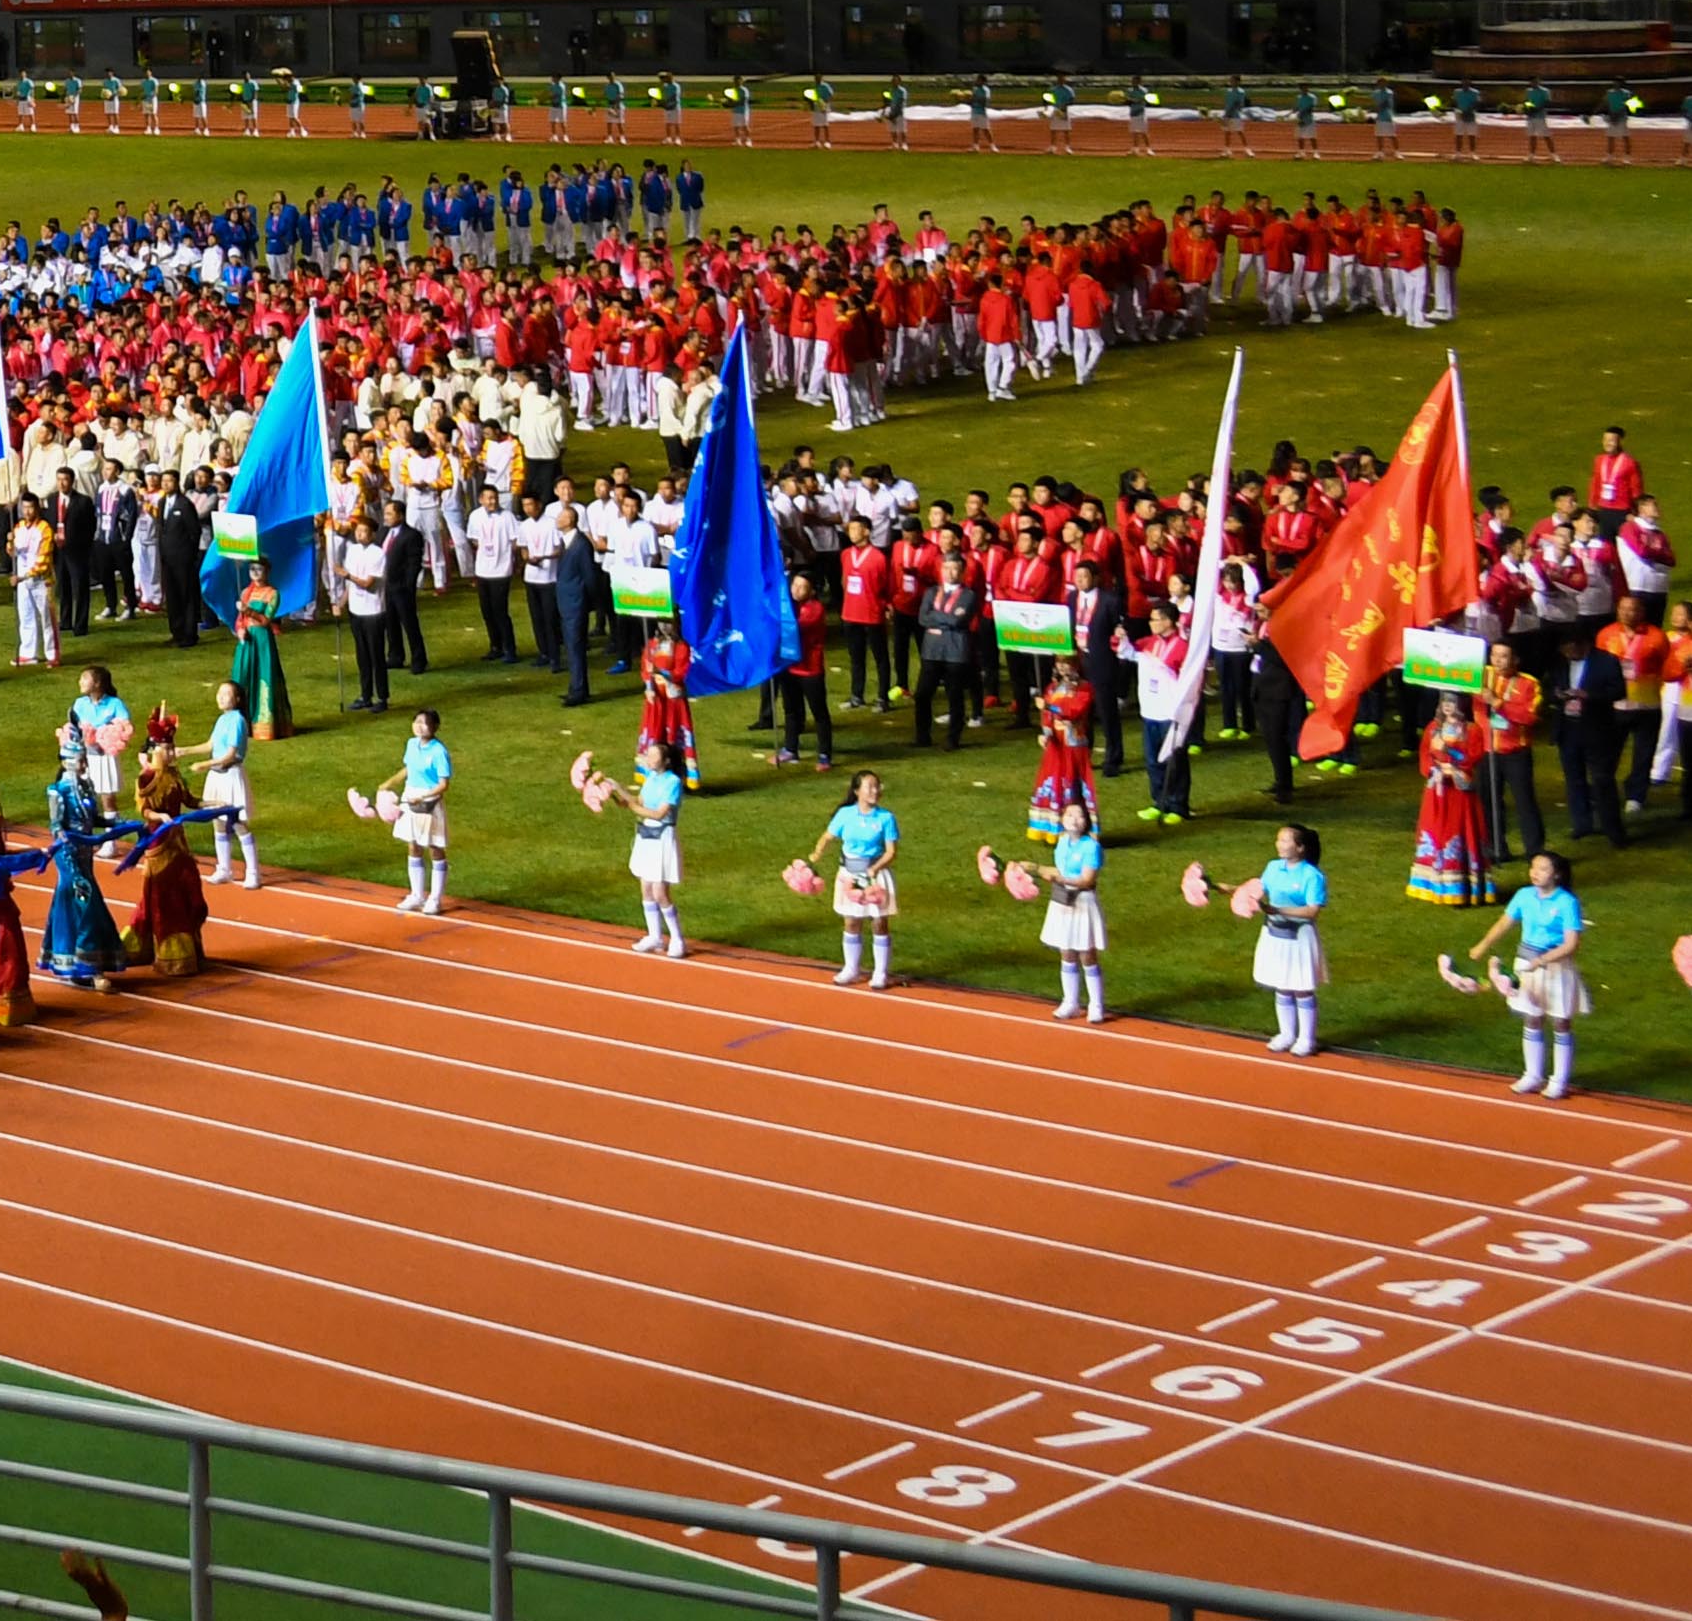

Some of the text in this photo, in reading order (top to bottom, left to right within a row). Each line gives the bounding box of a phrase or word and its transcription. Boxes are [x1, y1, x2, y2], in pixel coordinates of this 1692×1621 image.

[1579, 1191, 1691, 1226] 2
[1486, 1230, 1592, 1264] 3
[1377, 1277, 1484, 1309] 4
[1269, 1316, 1384, 1355] 5
[1151, 1364, 1265, 1402] 6
[1034, 1410, 1153, 1448] 7
[895, 1464, 1017, 1508] 8
